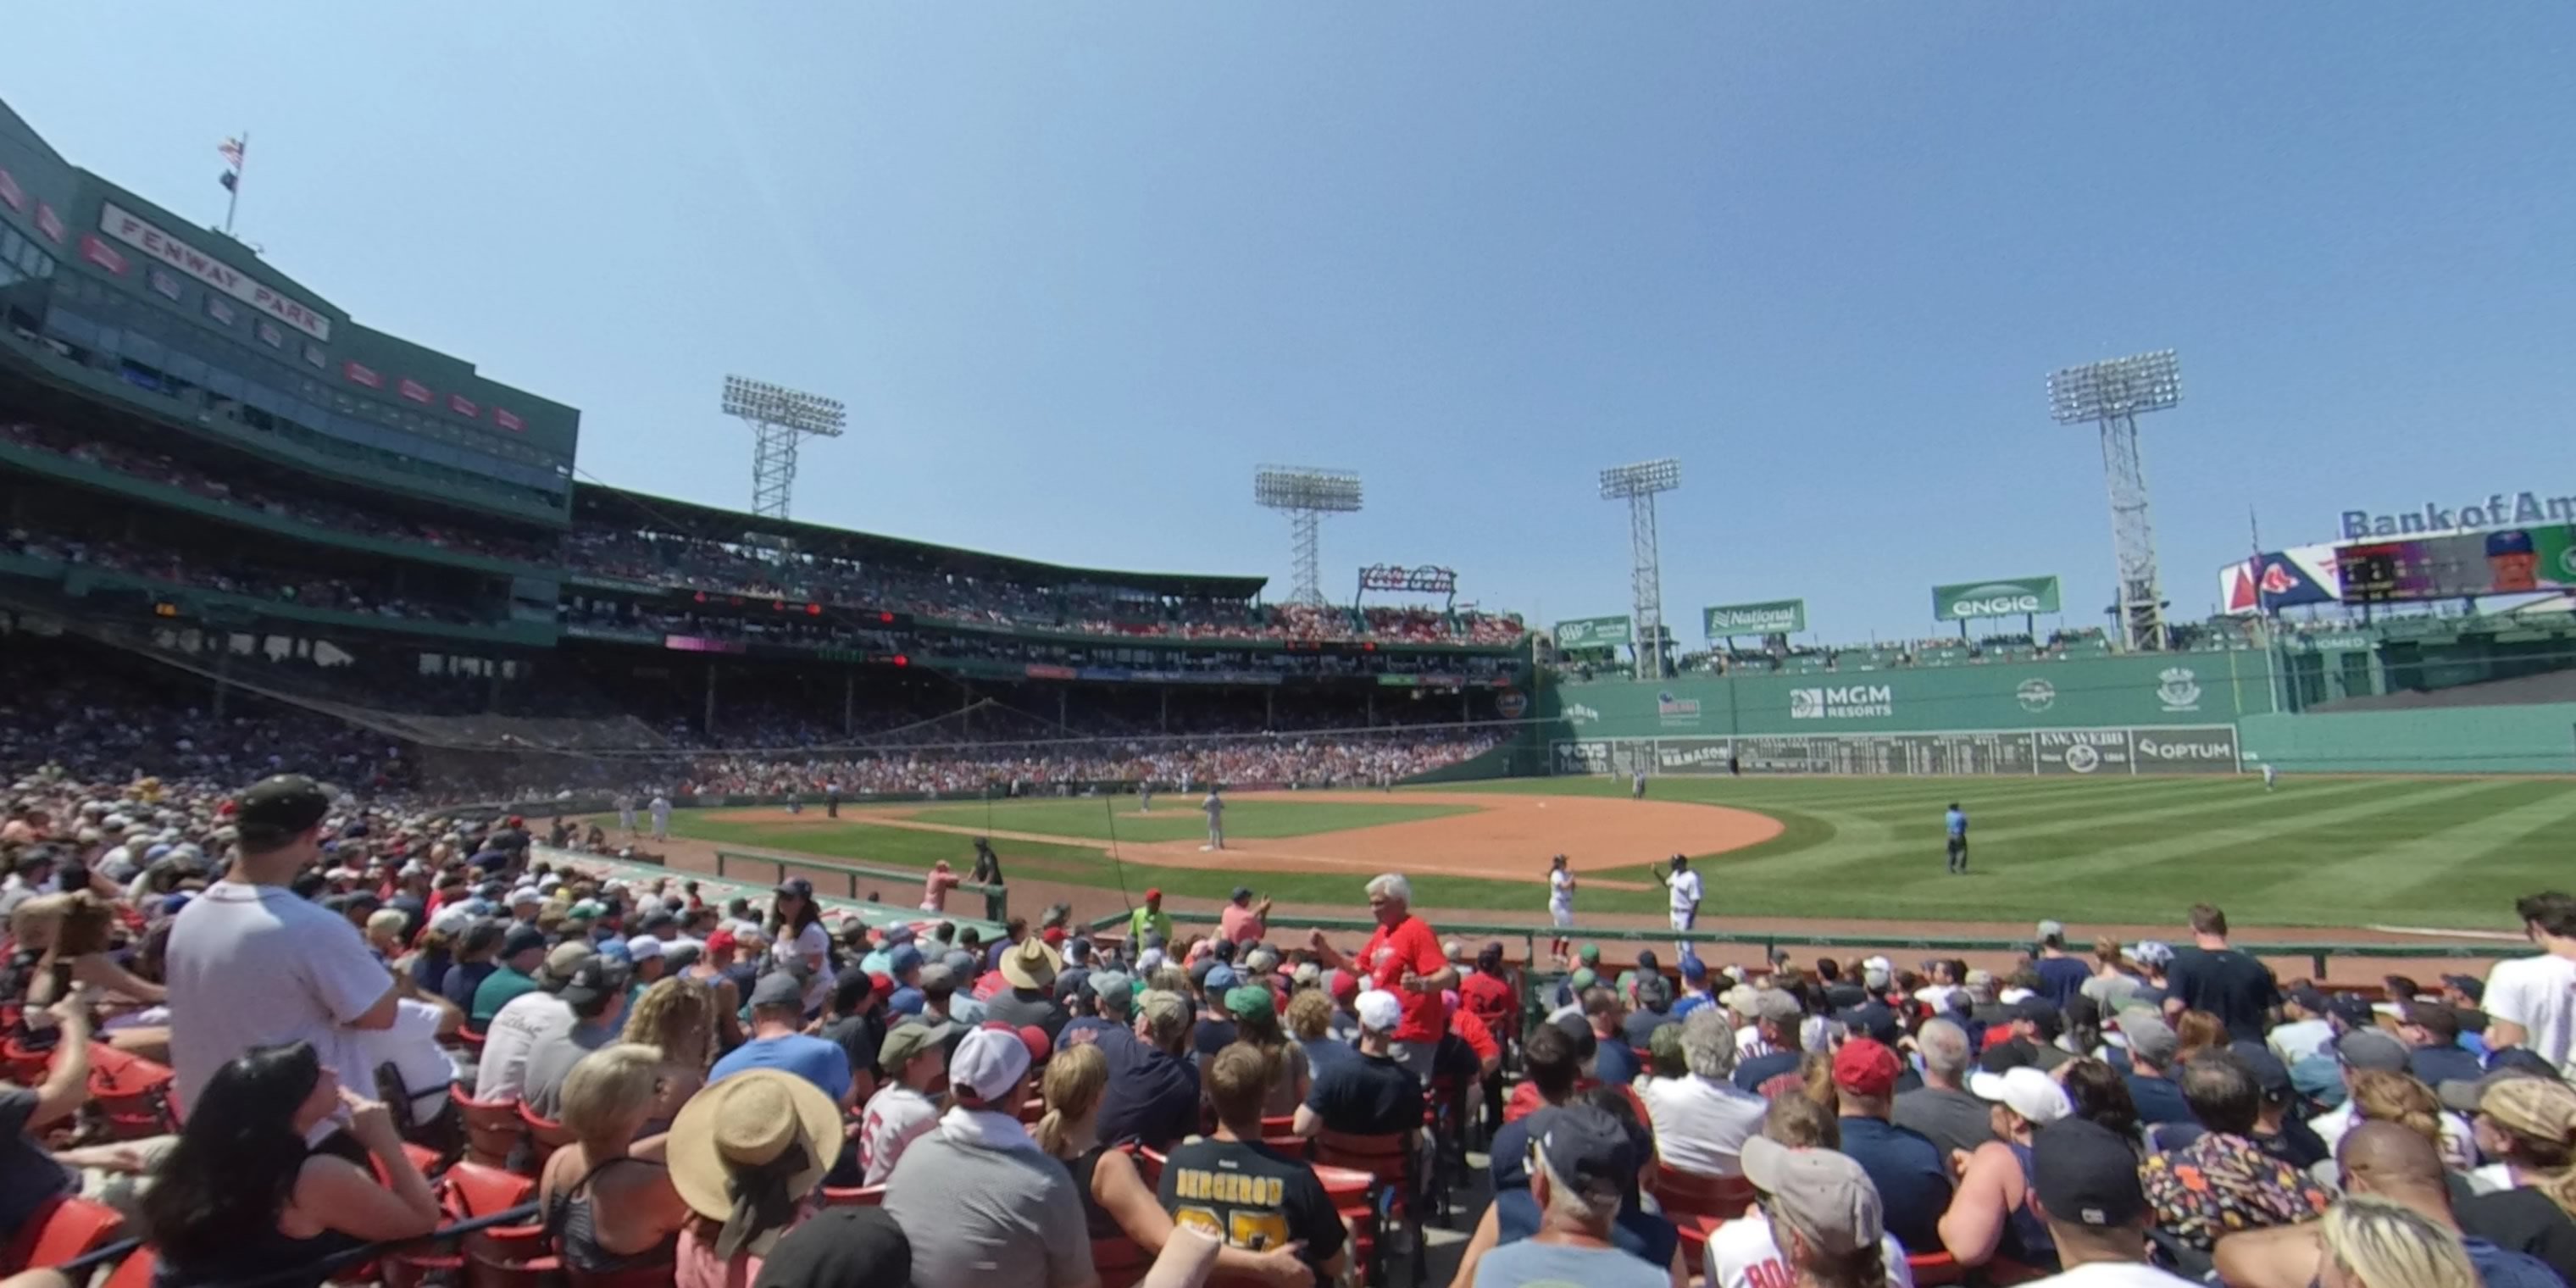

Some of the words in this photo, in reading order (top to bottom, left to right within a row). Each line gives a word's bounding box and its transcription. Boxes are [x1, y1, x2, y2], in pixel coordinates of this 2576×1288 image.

[120, 218, 240, 290] FENWAY
[256, 289, 318, 331] PARK
[2340, 502, 2453, 540] Bank
[2459, 495, 2505, 527] of
[1730, 607, 1794, 625] National
[1826, 686, 1891, 705] MGM
[1827, 704, 1892, 718] RESORTS
[1574, 742, 1607, 758] CVS
[2160, 743, 2230, 759] OPTUM
